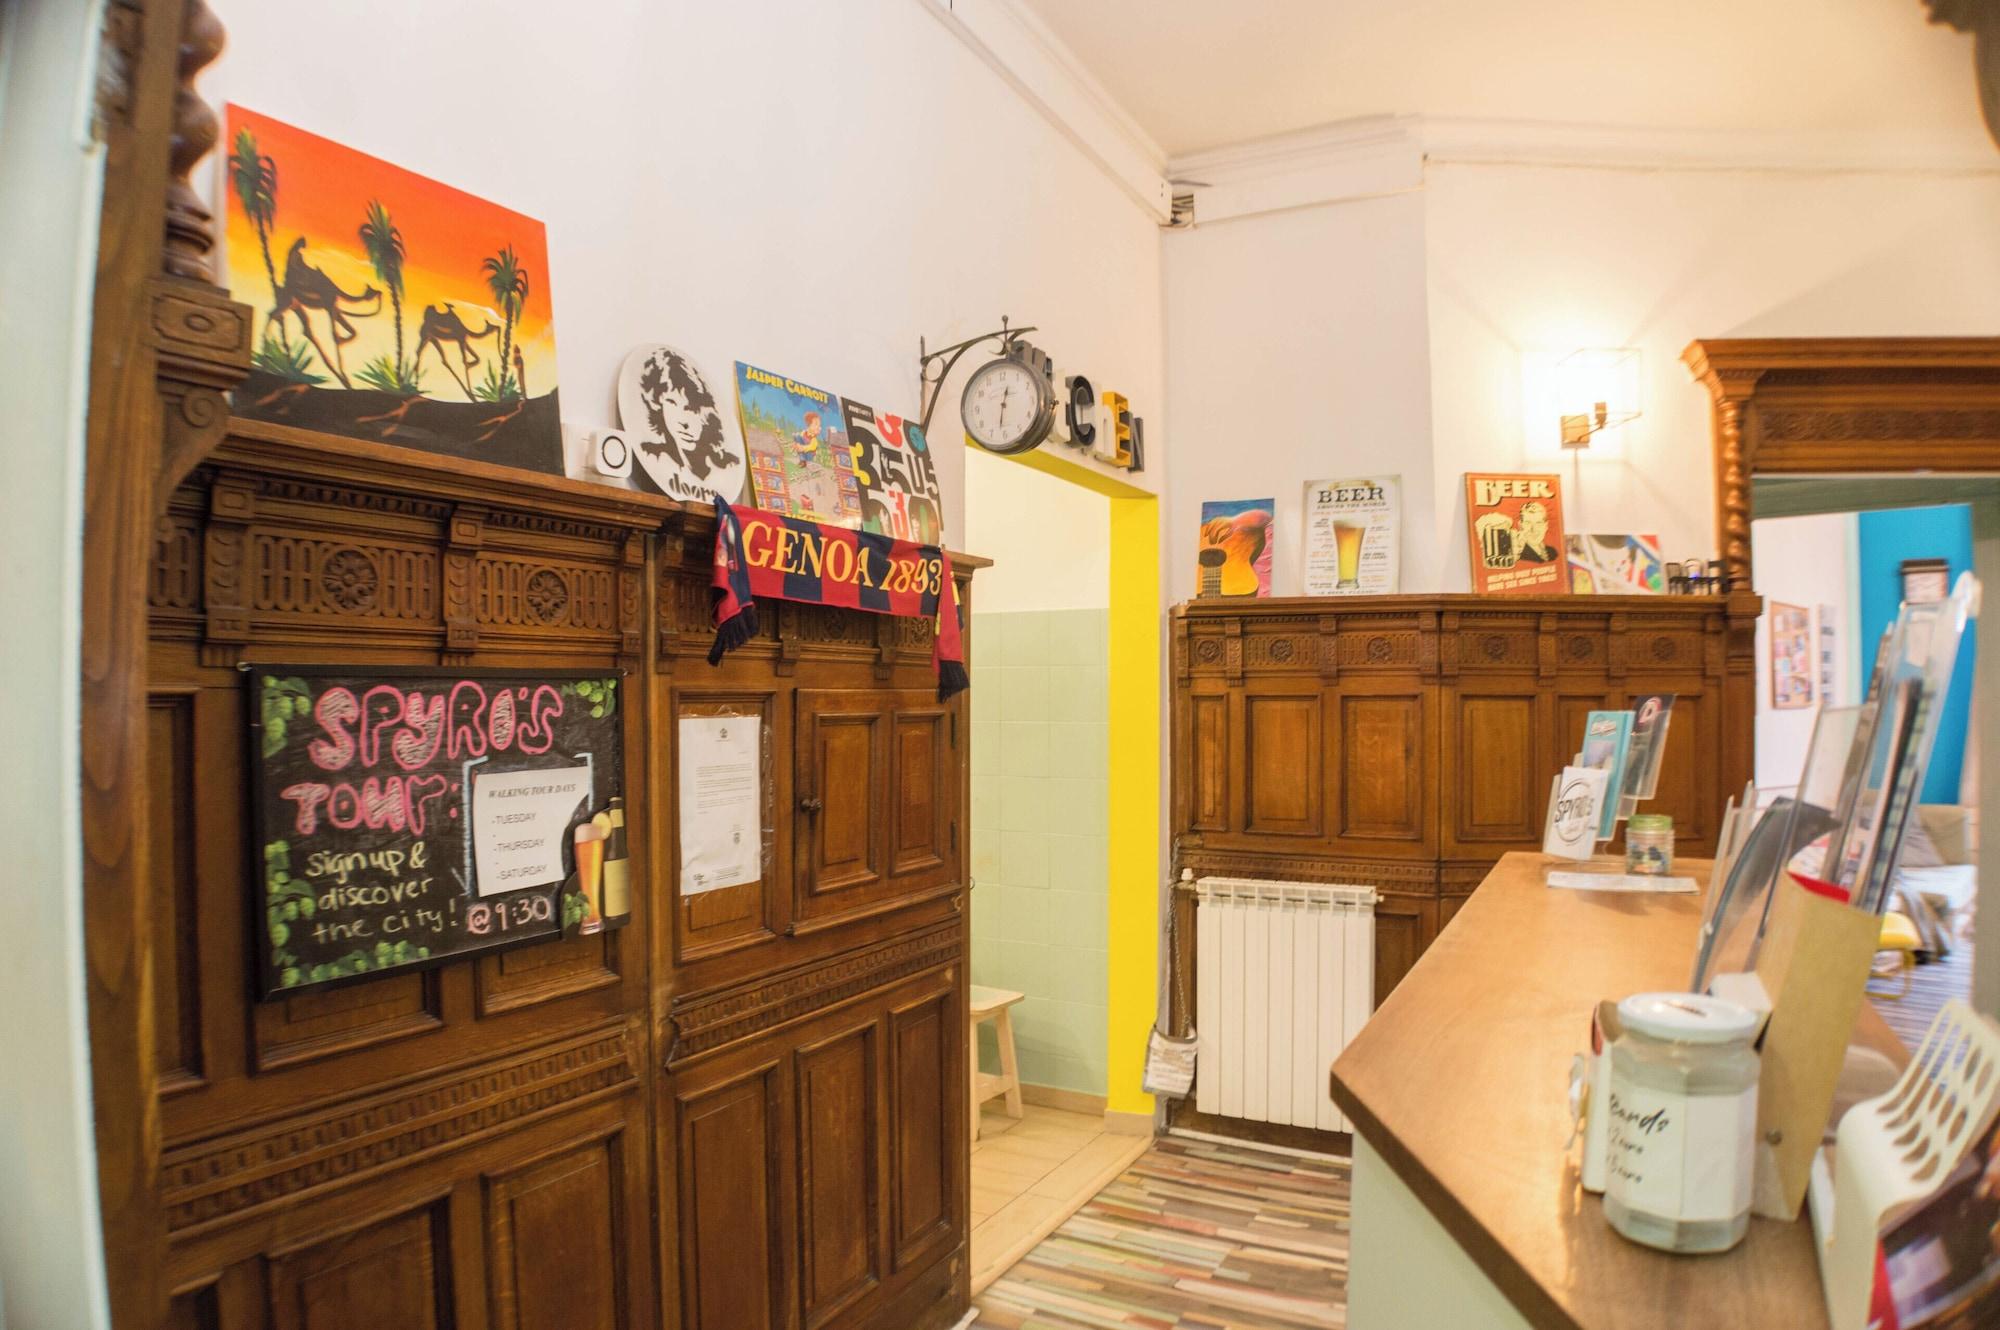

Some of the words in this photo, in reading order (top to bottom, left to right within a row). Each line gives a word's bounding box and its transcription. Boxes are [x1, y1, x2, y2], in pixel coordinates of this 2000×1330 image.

[785, 379, 829, 404] CARROTT
[1317, 487, 1385, 504] BEER
[1474, 480, 1556, 507] BEER
[741, 520, 874, 587] GENOA
[880, 558, 943, 596] 1893
[307, 680, 563, 770] SPYRO'S
[318, 876, 434, 911] discover
[311, 918, 374, 944] the
